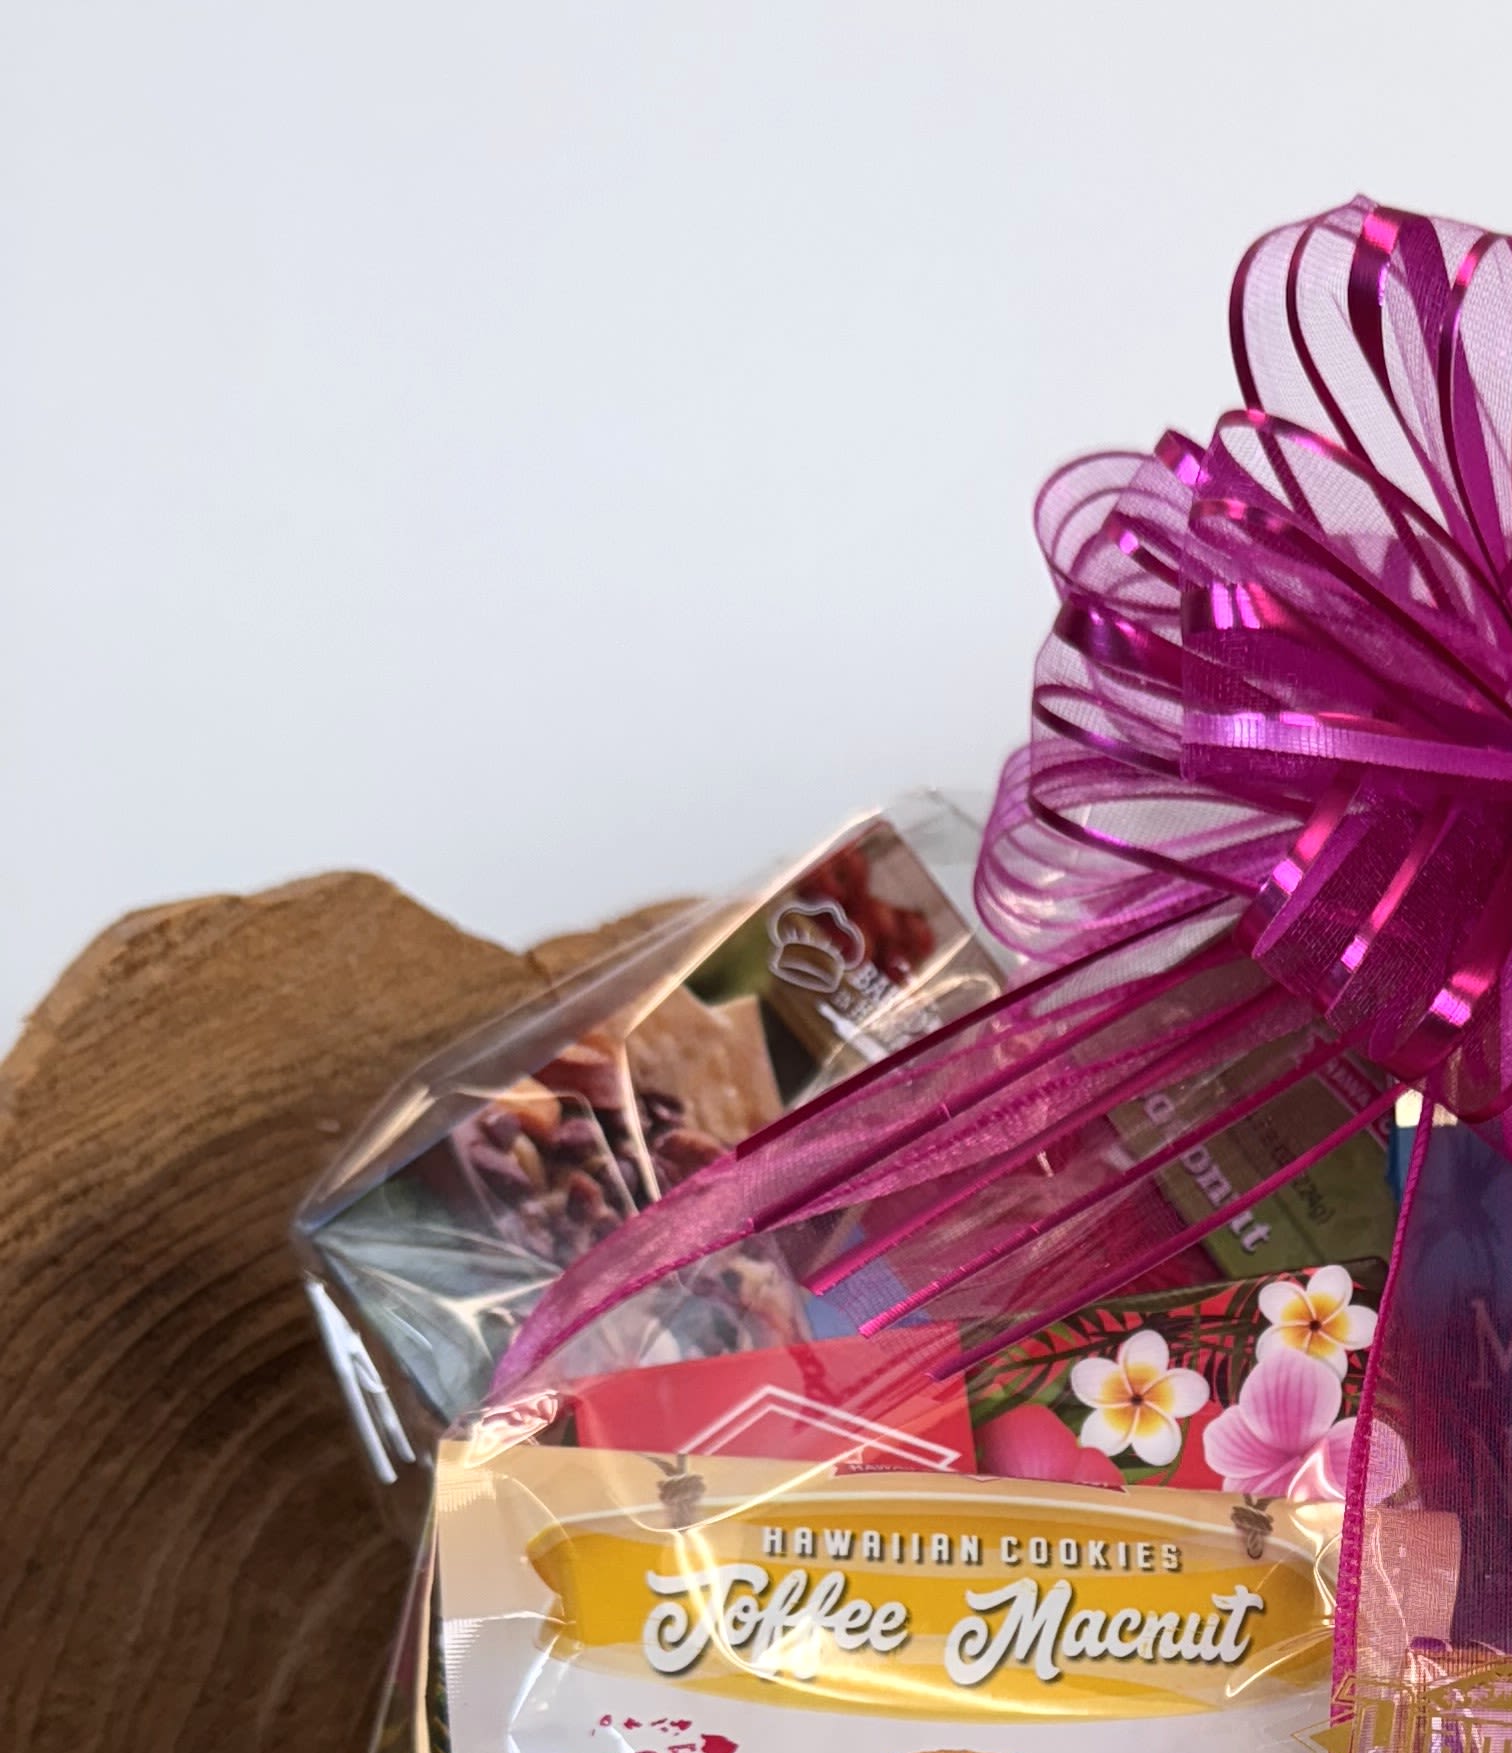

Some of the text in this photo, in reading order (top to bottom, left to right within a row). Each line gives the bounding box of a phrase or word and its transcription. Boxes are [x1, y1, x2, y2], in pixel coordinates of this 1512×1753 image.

[761, 1526, 1182, 1571] HAWAIIAN COOKIES
[642, 1562, 1264, 1686] Toffee Macnut
